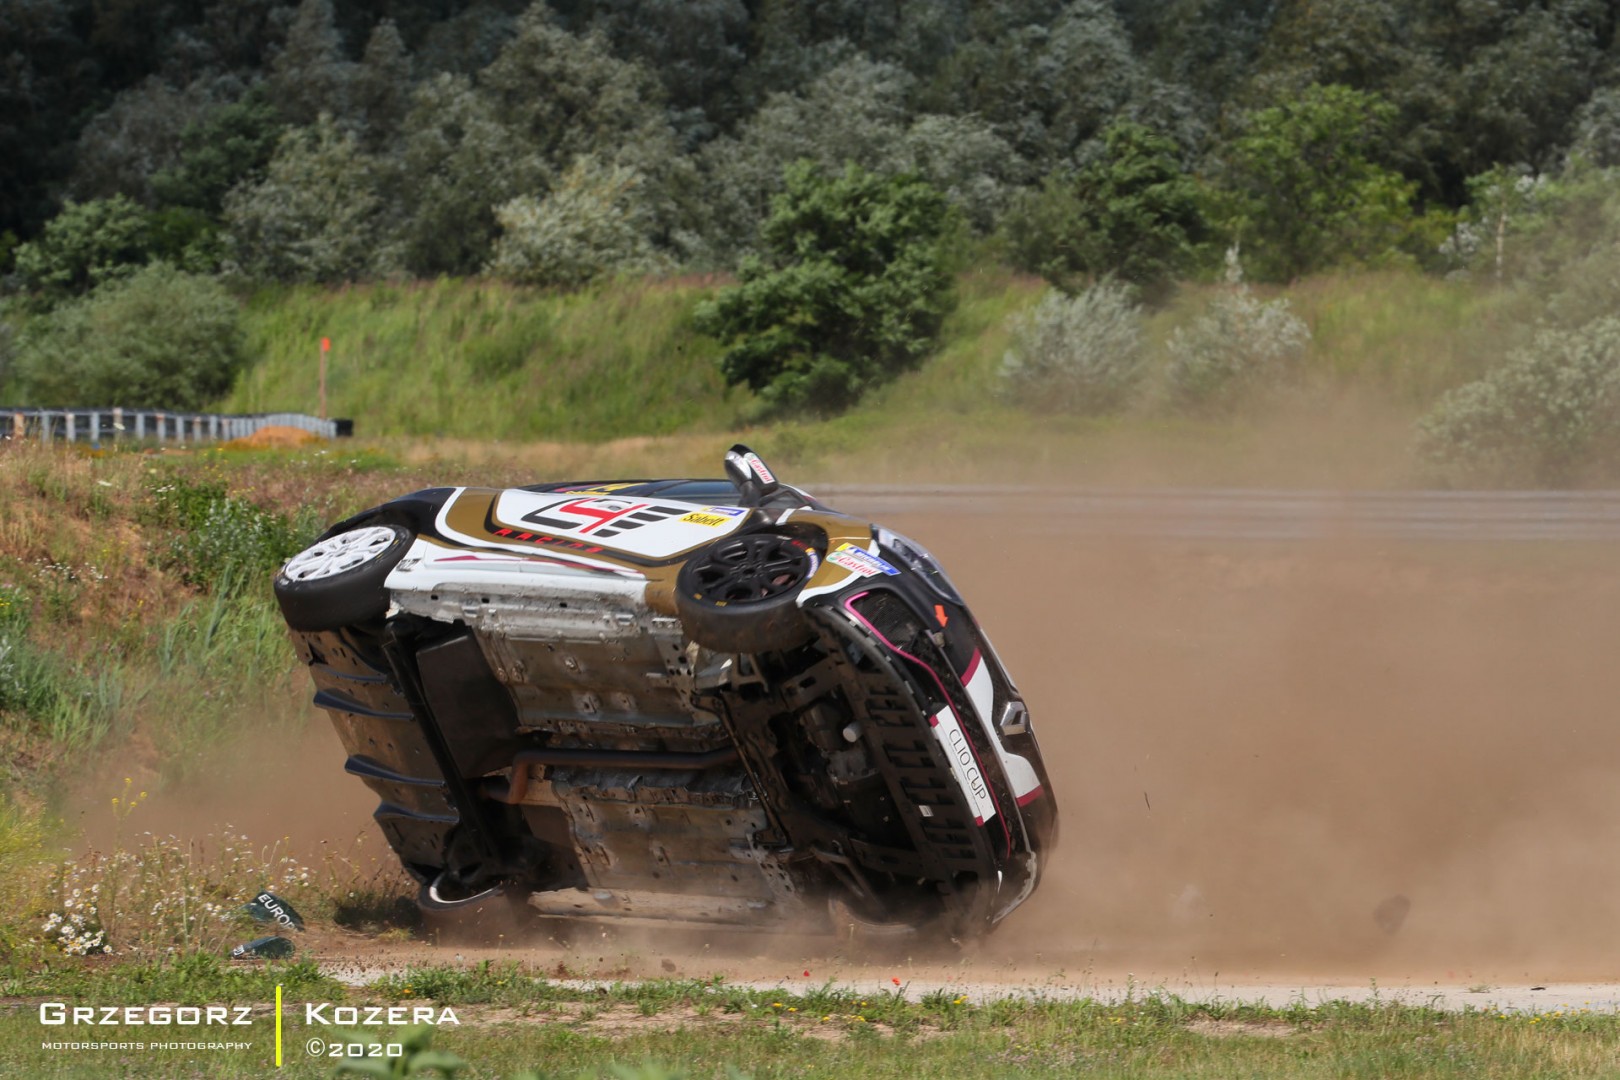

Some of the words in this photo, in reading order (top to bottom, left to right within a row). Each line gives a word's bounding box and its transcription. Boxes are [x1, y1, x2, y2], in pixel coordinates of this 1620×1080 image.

[682, 512, 726, 527] Sabelt
[948, 728, 972, 766] CLIO
[966, 767, 988, 801] CUP
